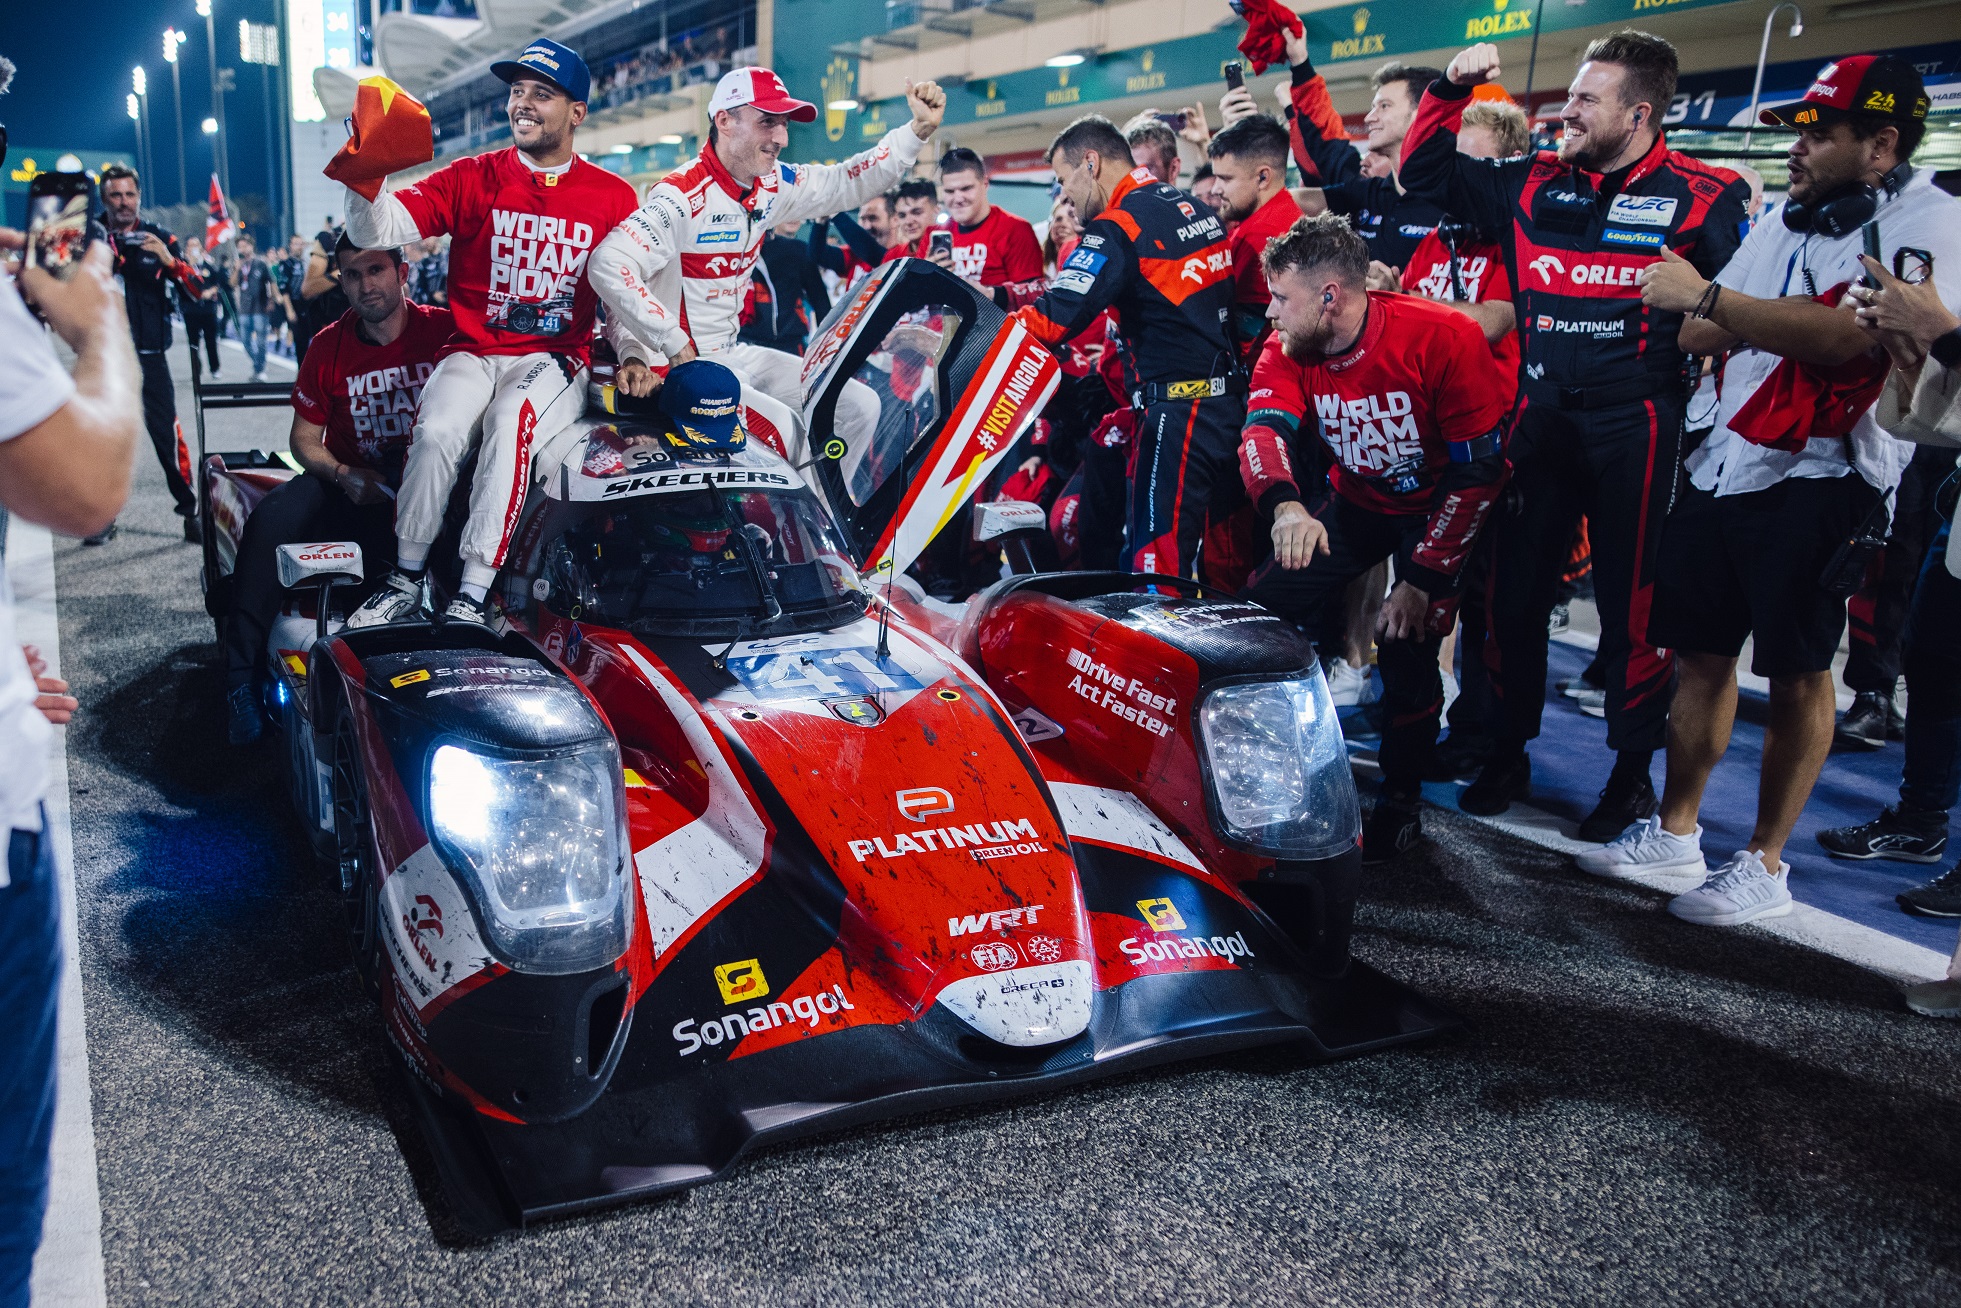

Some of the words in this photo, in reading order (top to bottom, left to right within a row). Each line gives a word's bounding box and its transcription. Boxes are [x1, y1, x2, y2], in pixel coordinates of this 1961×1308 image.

[1465, 9, 1533, 40] ROLEX
[1330, 34, 1386, 60] ROLEX
[1126, 72, 1167, 93] ROLEX
[1795, 108, 1818, 123] 41
[1694, 181, 1717, 194] OMP
[1616, 198, 1674, 211] WEC
[492, 209, 593, 249] WORLD
[711, 214, 740, 223] WRT
[700, 231, 738, 242] GOODYEAR
[1607, 232, 1660, 244] GOODYEAR
[490, 235, 589, 278] CHAM
[490, 261, 579, 299] PIONS
[835, 279, 883, 339] ORLEN
[545, 317, 560, 329] 41
[1555, 319, 1625, 333] PLATINUM
[1342, 349, 1365, 368] ORLEN
[346, 362, 434, 398] WORLD
[528, 360, 551, 386] ANDRADE
[1264, 409, 1284, 417] LANE
[1245, 439, 1264, 476] ORLEN
[602, 471, 789, 498] SKECHERS
[1402, 478, 1417, 490] 41
[1000, 508, 1042, 517] ORLEN
[1431, 494, 1462, 539] ORLEN
[299, 552, 354, 560] ORLEN
[748, 637, 819, 649] WEC
[435, 667, 556, 679] Sonangol
[767, 649, 899, 693] 41
[1073, 651, 1126, 691] Drive
[1126, 678, 1177, 716] Fast
[1068, 674, 1101, 703] Act
[1100, 690, 1174, 737] Faster
[847, 818, 1039, 862] PLATINUM
[974, 846, 1014, 859] ORLEN
[1016, 843, 1048, 855] OIL
[949, 905, 1044, 936] WRT
[402, 914, 438, 974] ORLEN
[1119, 931, 1255, 965] Sonangol
[972, 947, 1014, 968] FIA
[1001, 981, 1048, 994] ORECA
[672, 984, 854, 1057] Sonangol
